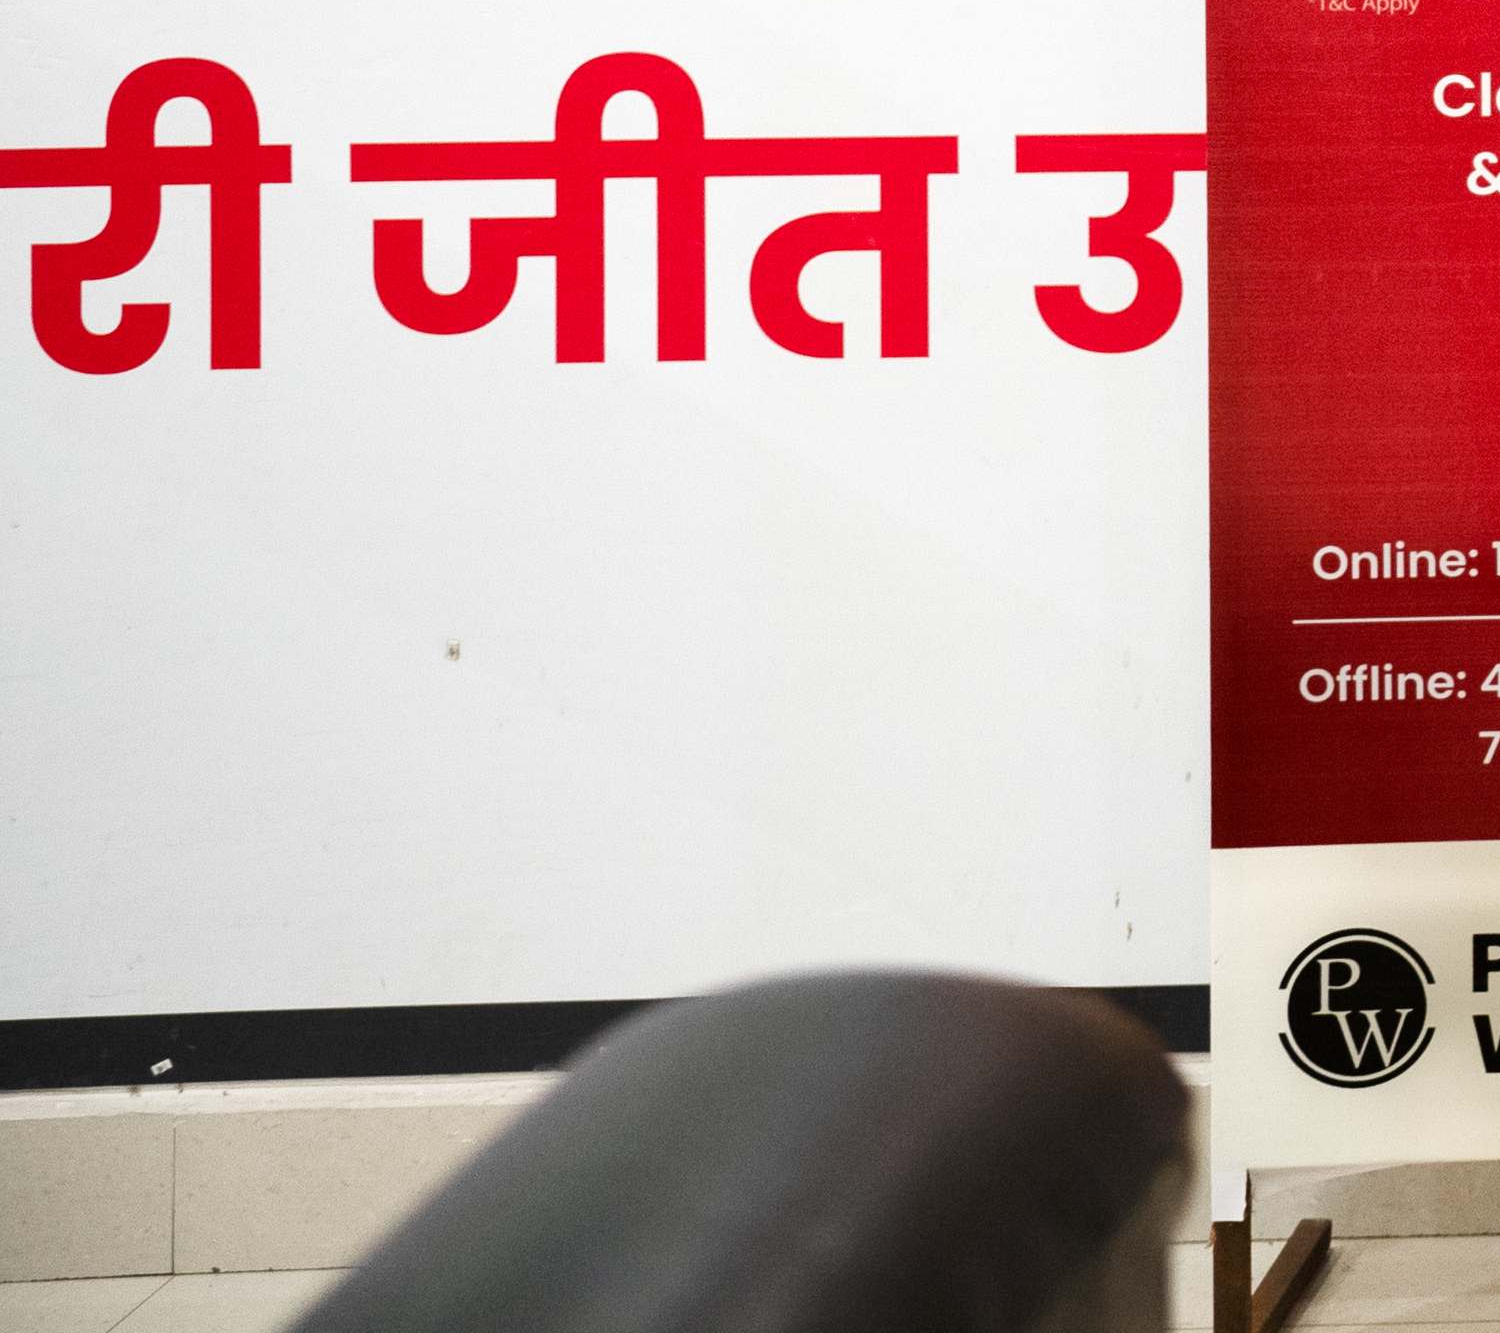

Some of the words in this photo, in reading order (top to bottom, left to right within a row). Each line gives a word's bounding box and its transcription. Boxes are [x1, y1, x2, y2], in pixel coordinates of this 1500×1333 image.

[350, 52, 958, 365] जीत
[1312, 539, 1479, 581] Online:
[1298, 662, 1467, 703] Offline:
